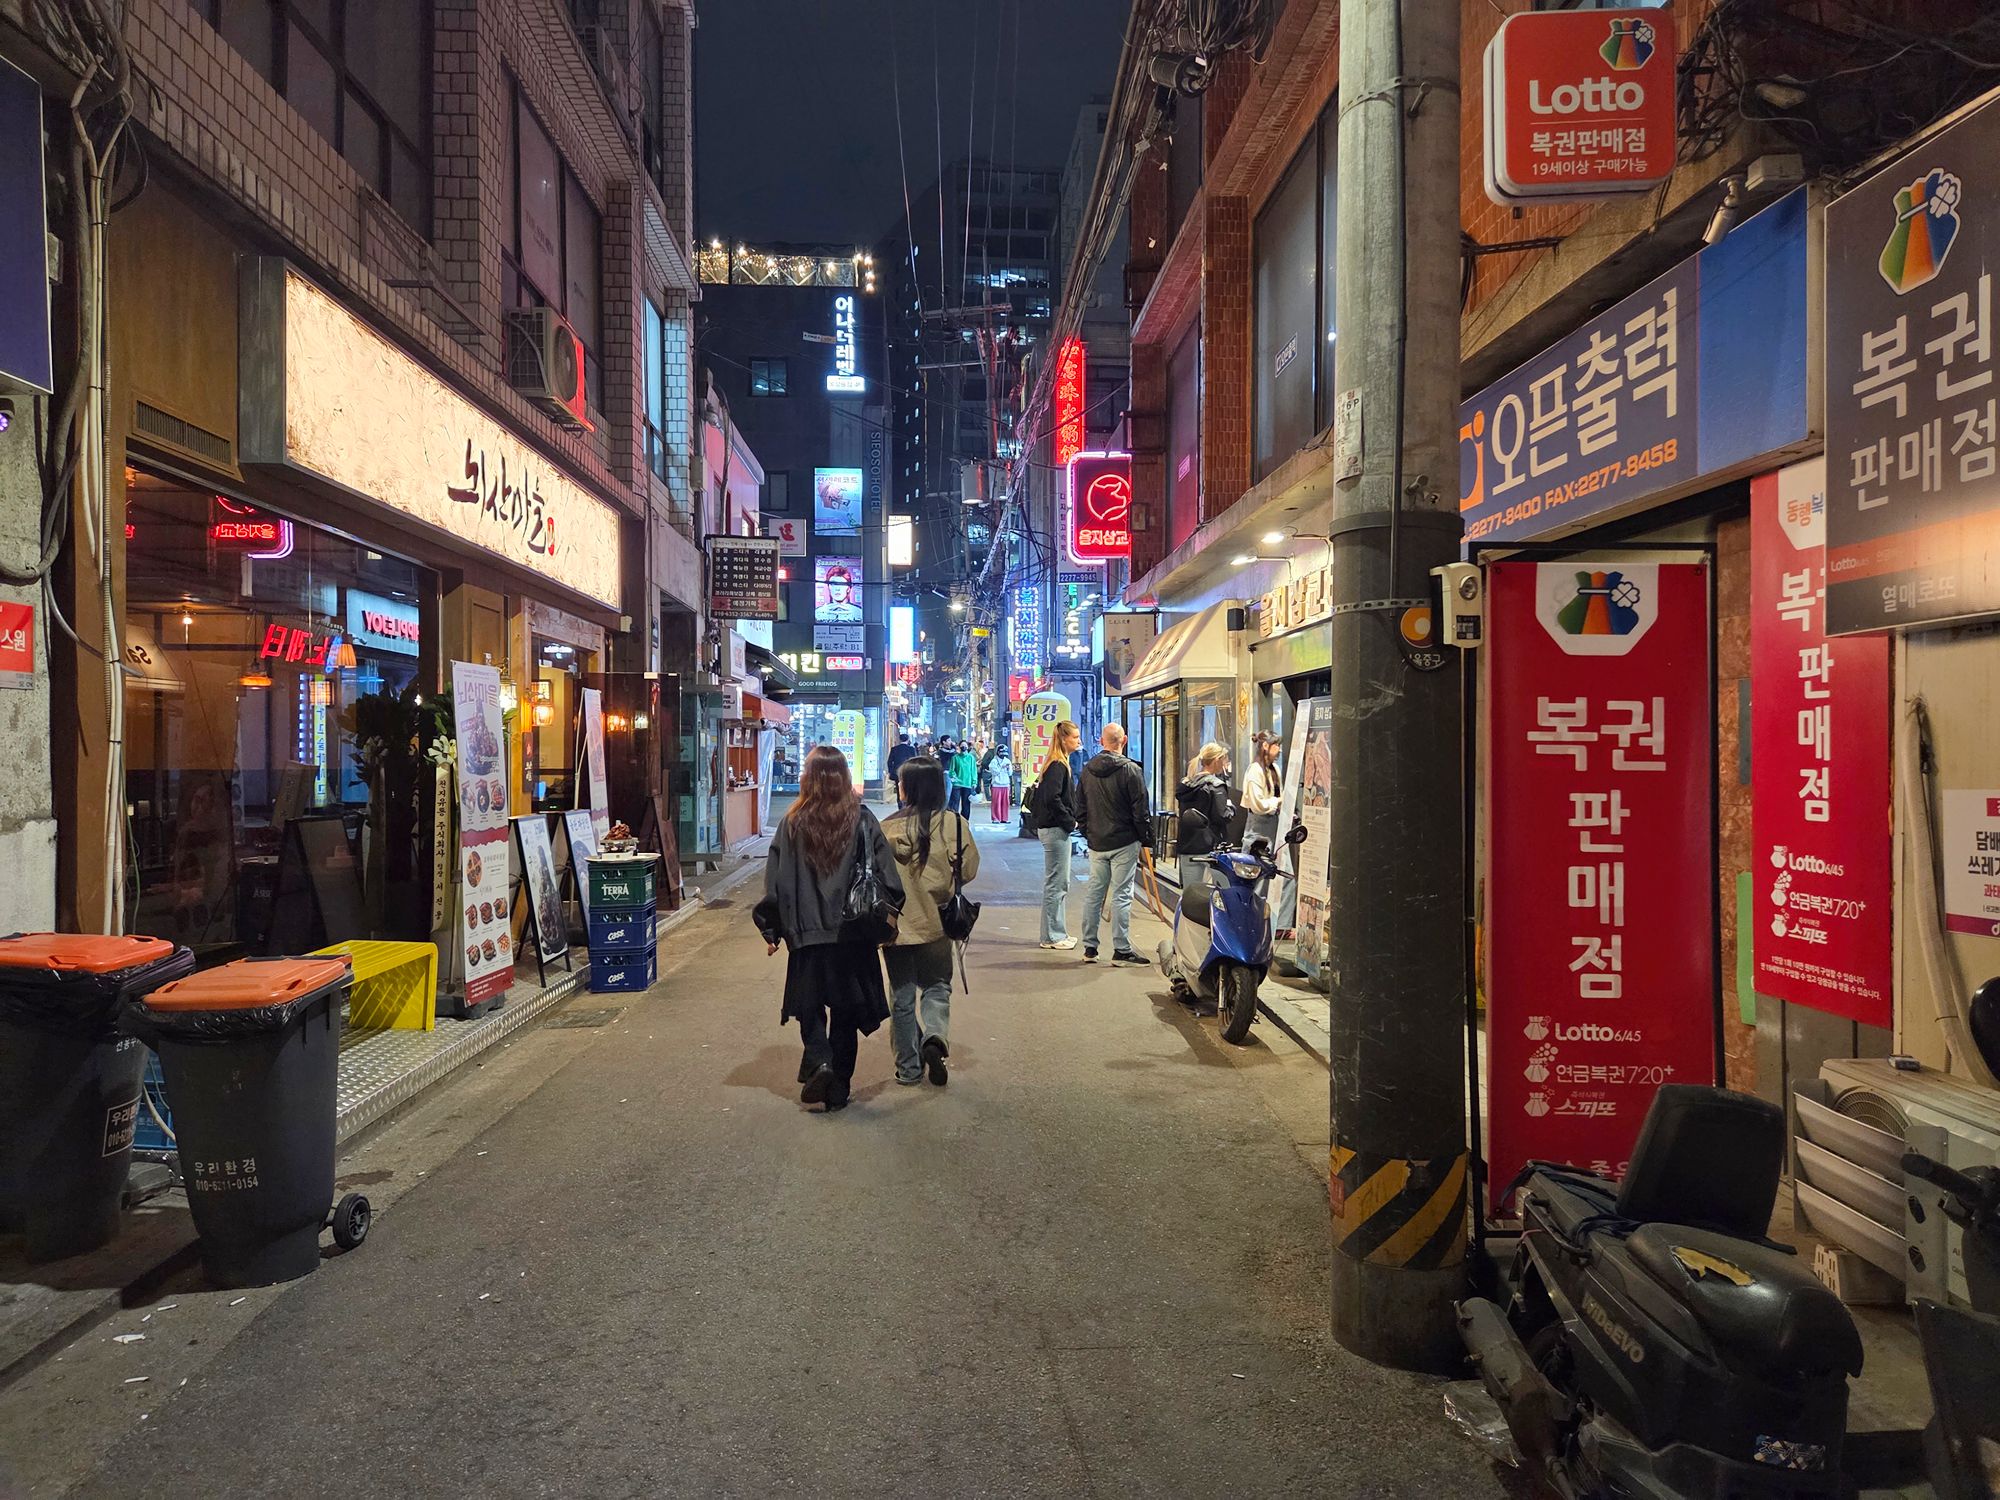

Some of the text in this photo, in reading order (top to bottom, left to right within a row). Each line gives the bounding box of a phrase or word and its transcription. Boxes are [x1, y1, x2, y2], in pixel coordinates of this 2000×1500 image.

[1528, 77, 1645, 115] Lotto
[1529, 128, 1647, 157] 복권판매점
[1531, 156, 1648, 176] 19세이상 구매가능
[1852, 274, 1994, 419] 복권
[1490, 287, 1679, 496] 오픈출력
[1850, 398, 1997, 511] 판매점
[1545, 438, 1679, 511] FAX:2277-8458
[1259, 571, 1334, 638] 을지삼교
[1777, 567, 1824, 632] 복
[1881, 576, 1956, 613] 열매로또
[1026, 703, 1058, 721] 한강
[1527, 696, 1667, 772] 복권
[1797, 643, 1835, 823] 판매점
[1567, 788, 1631, 998] 판매점
[607, 929, 625, 941] Cass
[1788, 924, 1828, 944] 스피또
[607, 971, 625, 984] Cass
[1800, 972, 1806, 981] 수
[1850, 985, 1856, 994] 수
[1836, 971, 1842, 980] 수
[1554, 1022, 1642, 1042] Lotto6/45
[1554, 1099, 1617, 1119] 스피또
